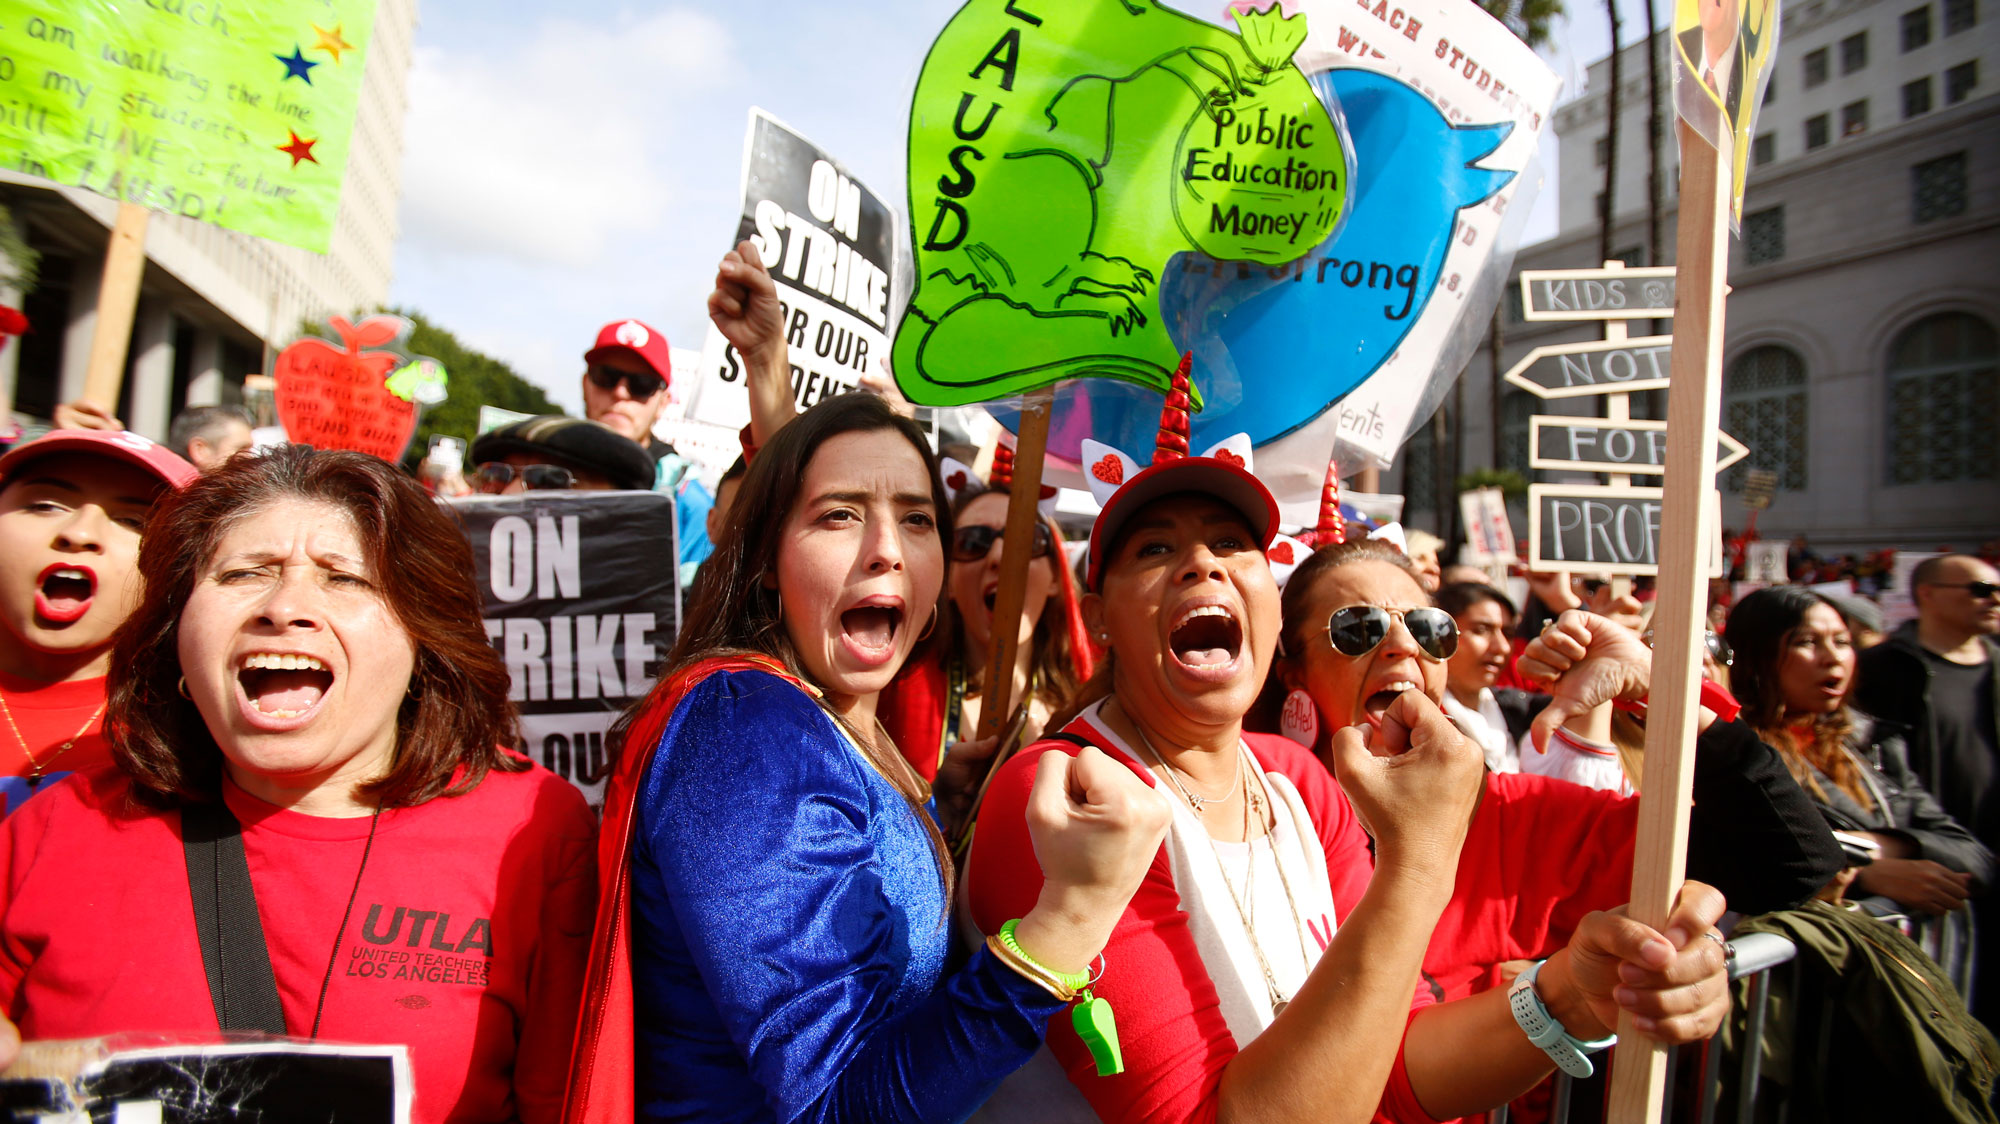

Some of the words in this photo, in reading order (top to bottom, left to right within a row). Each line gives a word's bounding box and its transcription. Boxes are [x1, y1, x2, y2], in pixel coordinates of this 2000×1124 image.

[27, 17, 76, 50] am
[101, 43, 210, 102] walking
[227, 82, 262, 109] the
[273, 91, 311, 124] line
[43, 69, 93, 110] my
[119, 92, 250, 147] students
[1214, 106, 1314, 149] Public
[225, 162, 298, 205] future
[1184, 147, 1338, 192] Education
[807, 158, 861, 242] ON
[750, 199, 889, 329] STRIKE
[1543, 279, 1627, 311] KIDS
[815, 319, 869, 373] OUR
[1558, 344, 1671, 386] NOT
[489, 514, 581, 603] ON
[1551, 499, 1662, 564] PROF
[542, 731, 610, 787] OU
[361, 903, 495, 958] UTLA
[346, 960, 389, 979] LOS
[393, 964, 490, 987] ANGELES
[351, 946, 411, 964] UNITED
[415, 952, 492, 974] TEACHERS
